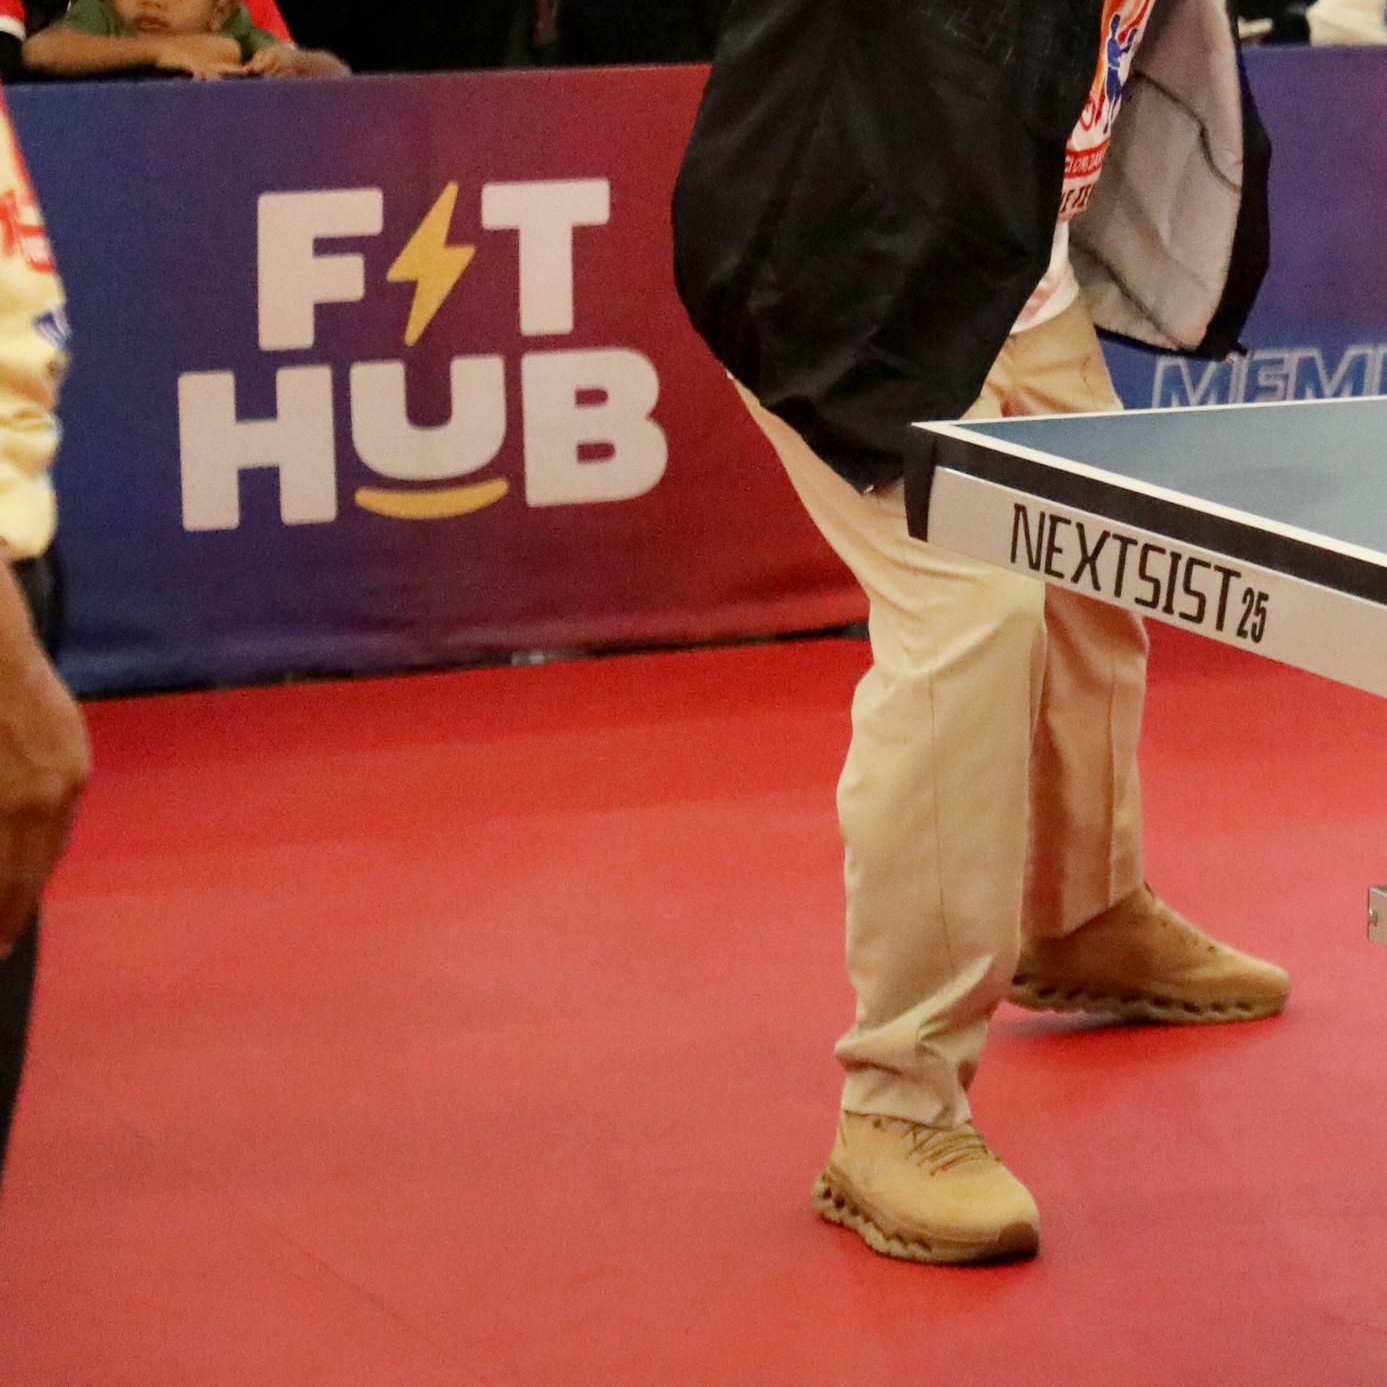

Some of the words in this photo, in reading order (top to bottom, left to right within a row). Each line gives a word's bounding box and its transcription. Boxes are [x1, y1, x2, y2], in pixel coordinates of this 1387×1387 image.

[178, 347, 668, 532] HUB
[1010, 503, 1241, 632] NEXTSIST
[1236, 587, 1270, 644] 25
